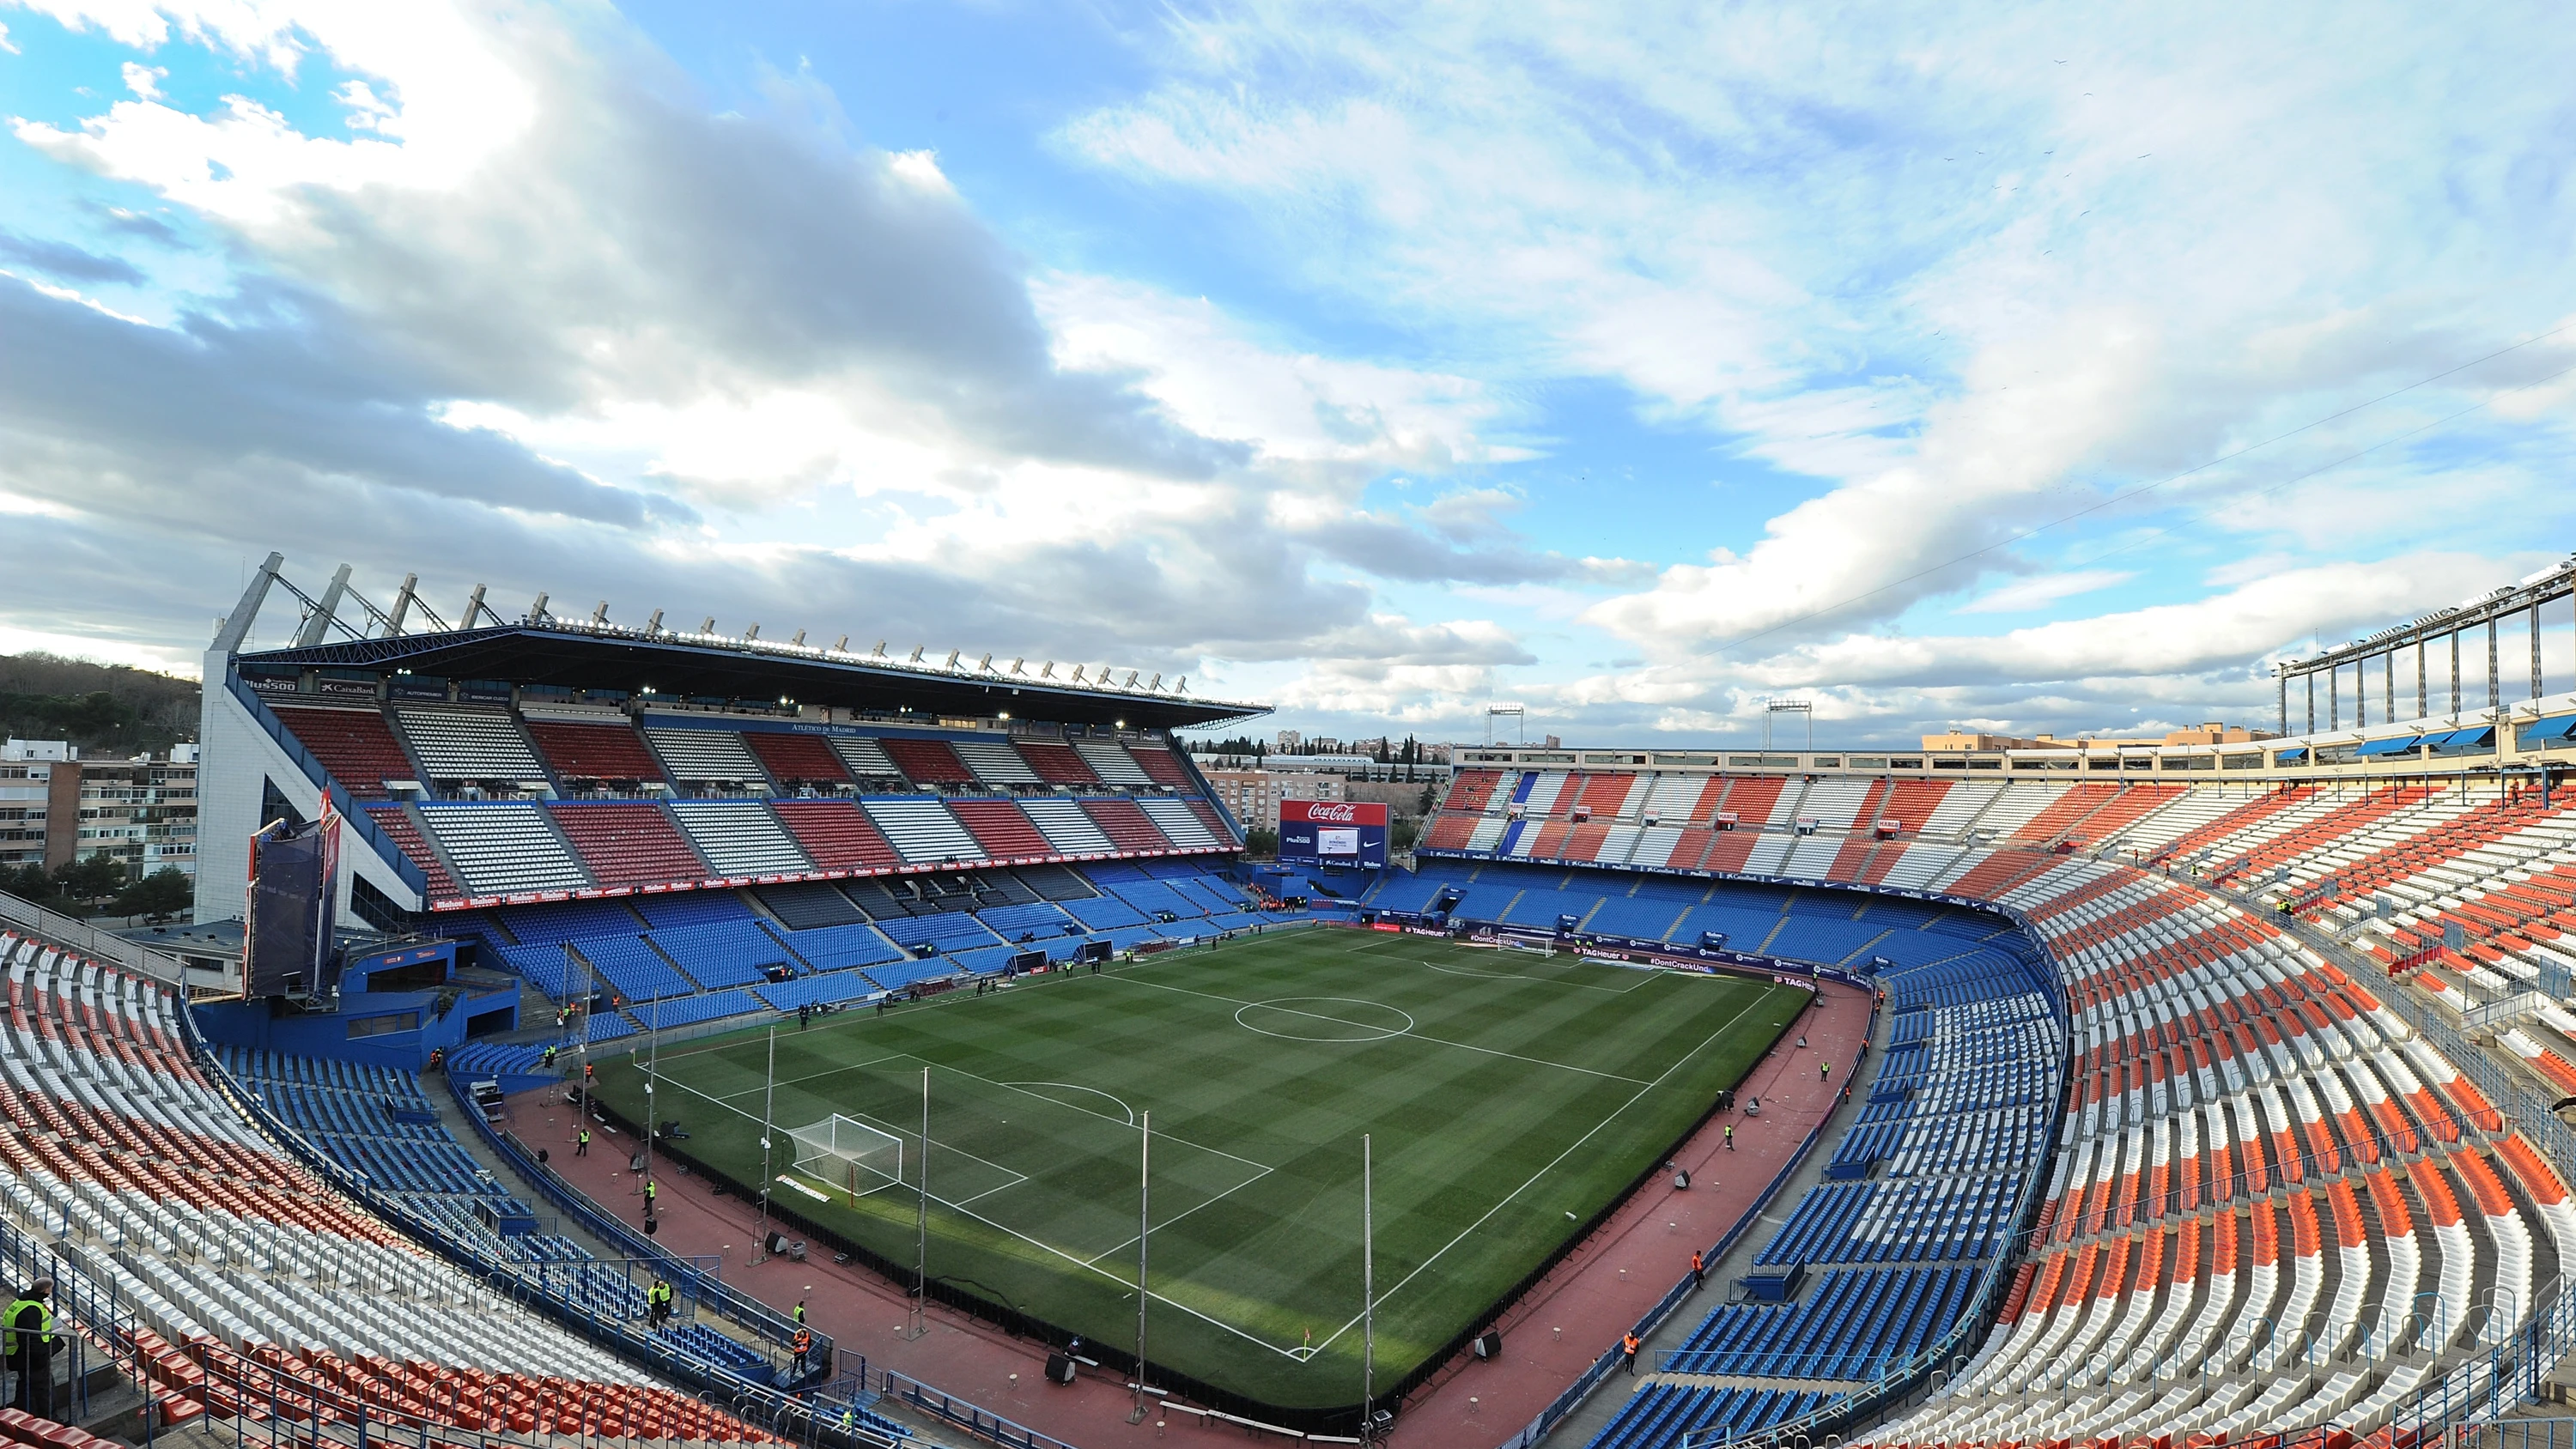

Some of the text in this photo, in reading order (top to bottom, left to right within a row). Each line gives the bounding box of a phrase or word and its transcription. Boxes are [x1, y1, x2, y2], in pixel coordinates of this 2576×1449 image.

[334, 684, 375, 694] CaixaBank
[1308, 803, 1356, 822] Coca-Cola
[510, 893, 536, 902] Mahou
[541, 891, 567, 900] Mahou
[436, 900, 464, 908] Mahou
[470, 896, 497, 906] Mahou
[1413, 927, 1445, 937] TAG Heuer
[1582, 948, 1620, 960] TAG Heuer
[1783, 977, 1801, 987] TAG
